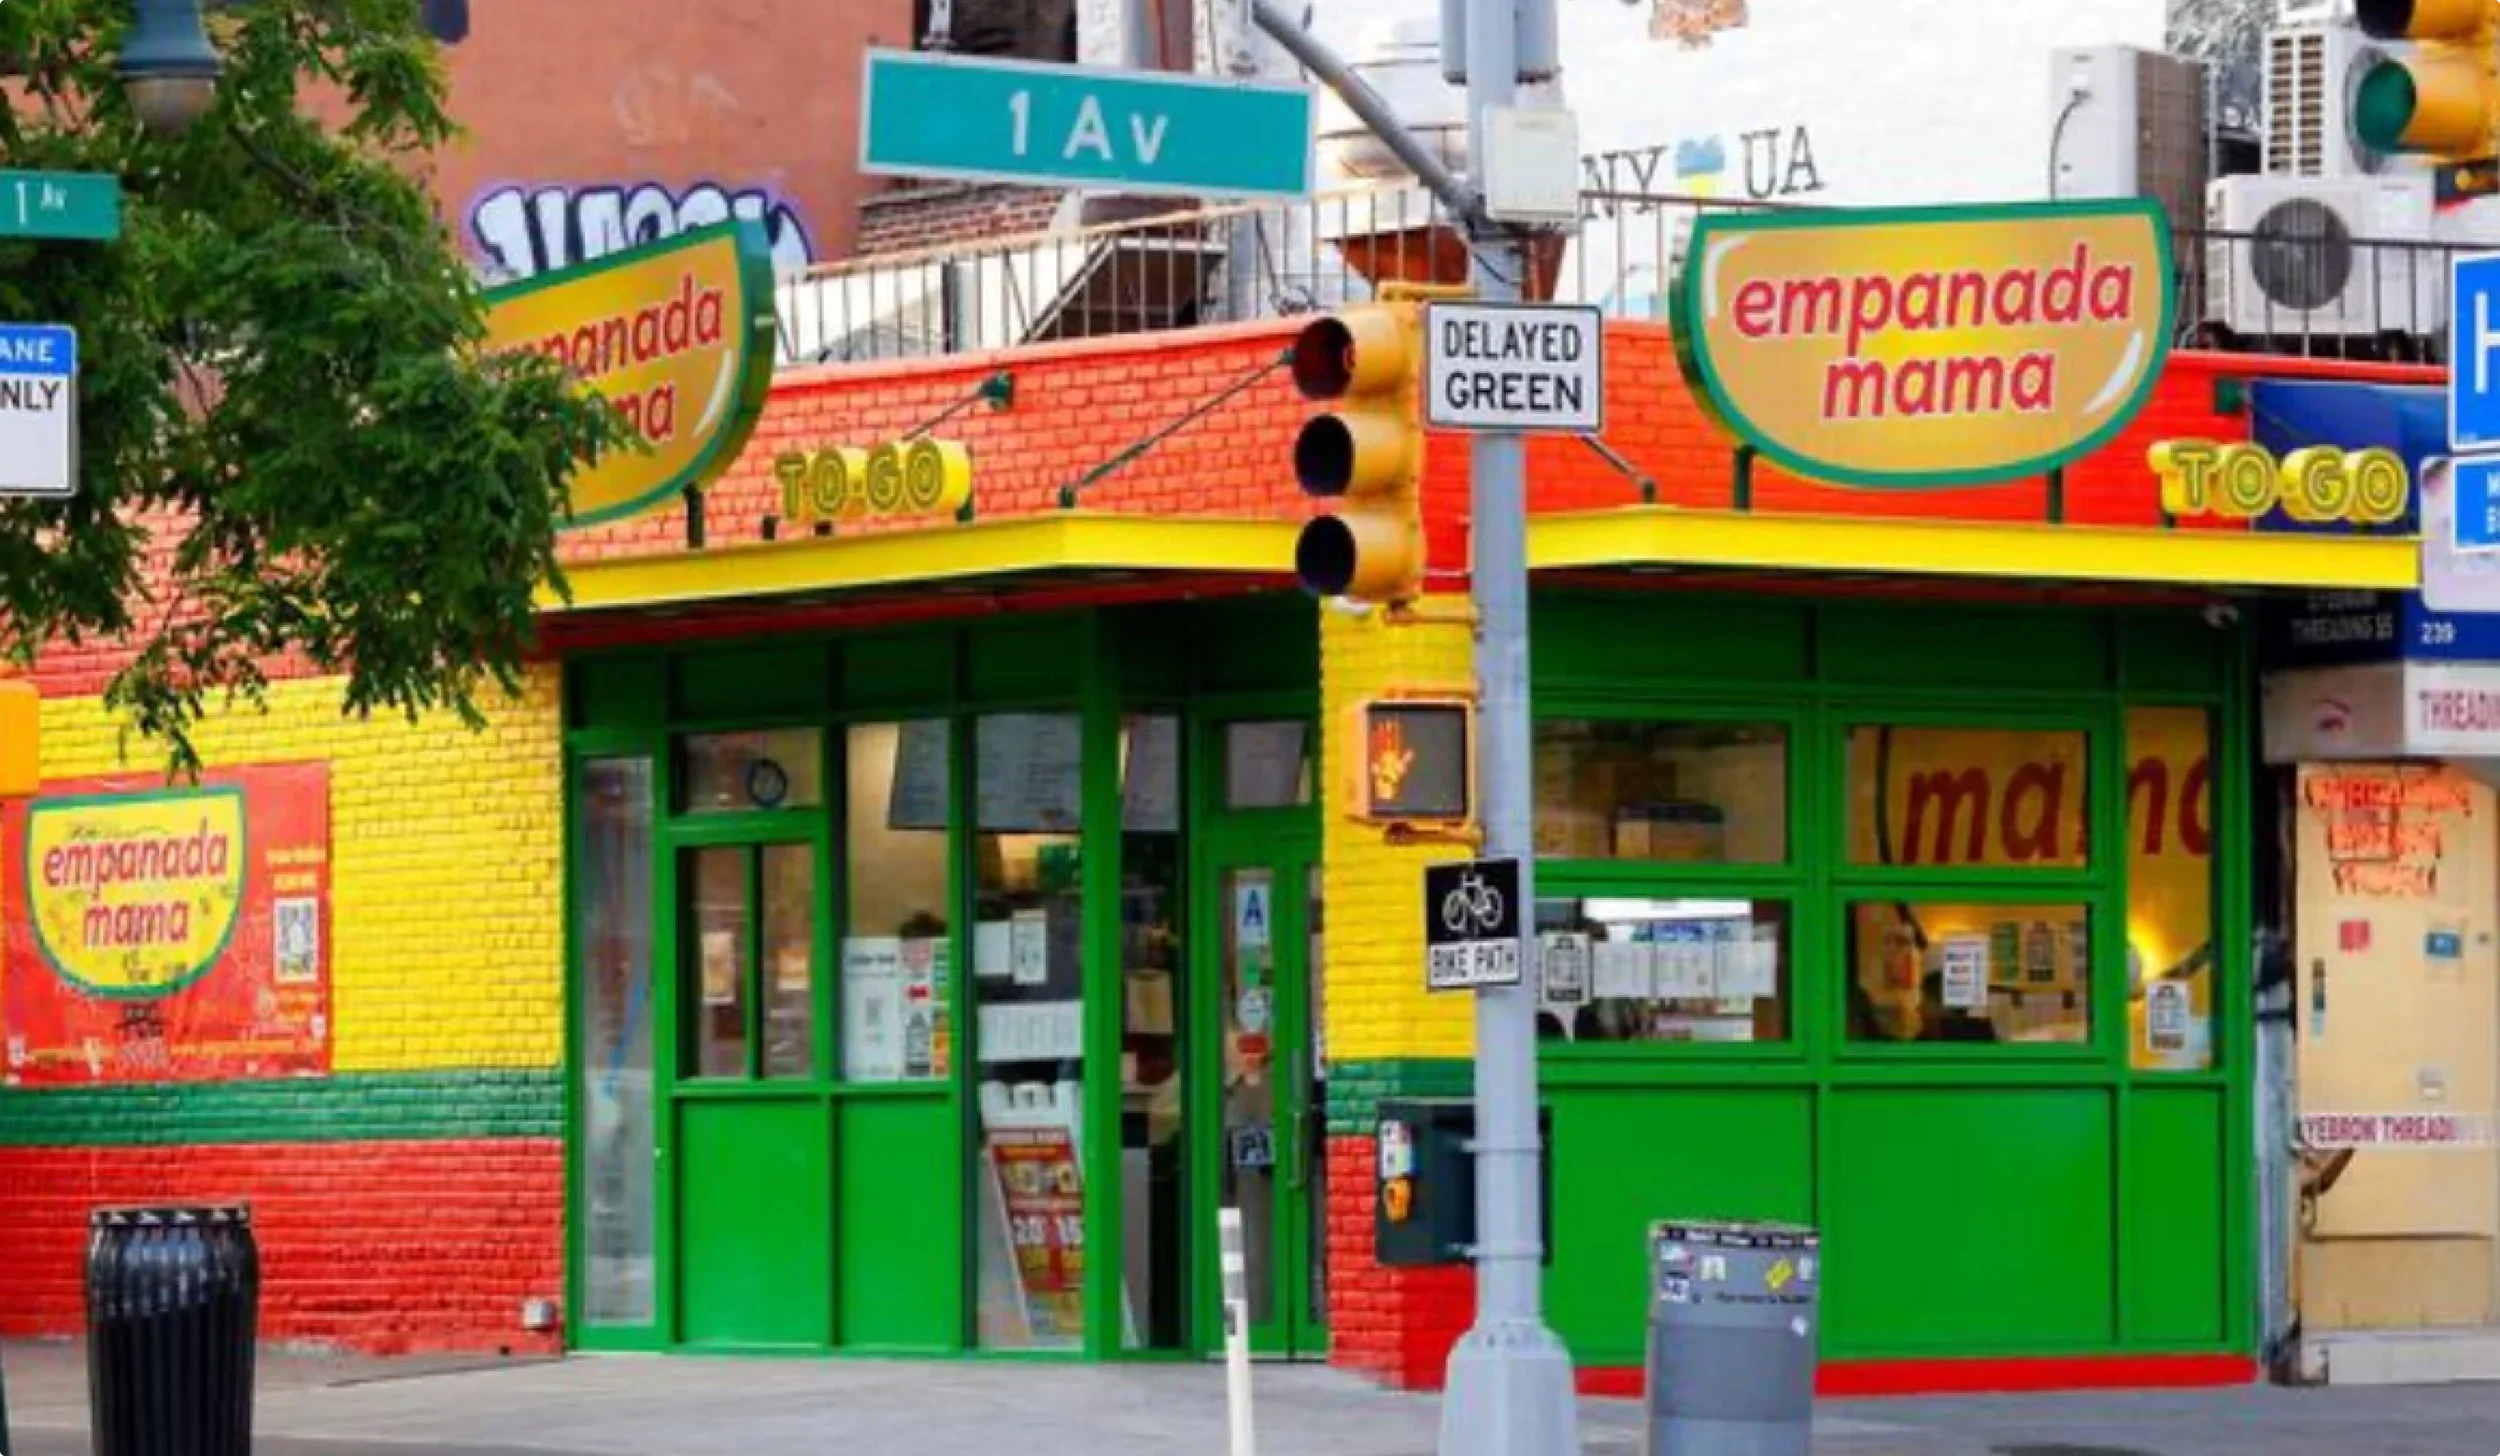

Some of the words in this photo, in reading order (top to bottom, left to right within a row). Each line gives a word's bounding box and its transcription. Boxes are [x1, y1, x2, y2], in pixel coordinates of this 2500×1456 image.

[1009, 91, 1030, 156] 1
[1064, 97, 1170, 165] Av
[1580, 145, 1668, 221] NY
[1738, 124, 1826, 200] UA
[15, 181, 26, 225] 1
[40, 182, 68, 211] Av
[1733, 243, 2133, 360] empanada
[1444, 320, 1582, 362] DELAYED
[1445, 371, 1582, 413] GREEN
[1822, 350, 2056, 418] mama
[43, 817, 229, 898] empanada
[83, 900, 190, 947] mama
[1243, 889, 1264, 926] A
[1433, 945, 1468, 979] BIKE
[1474, 942, 1517, 976] PATH
